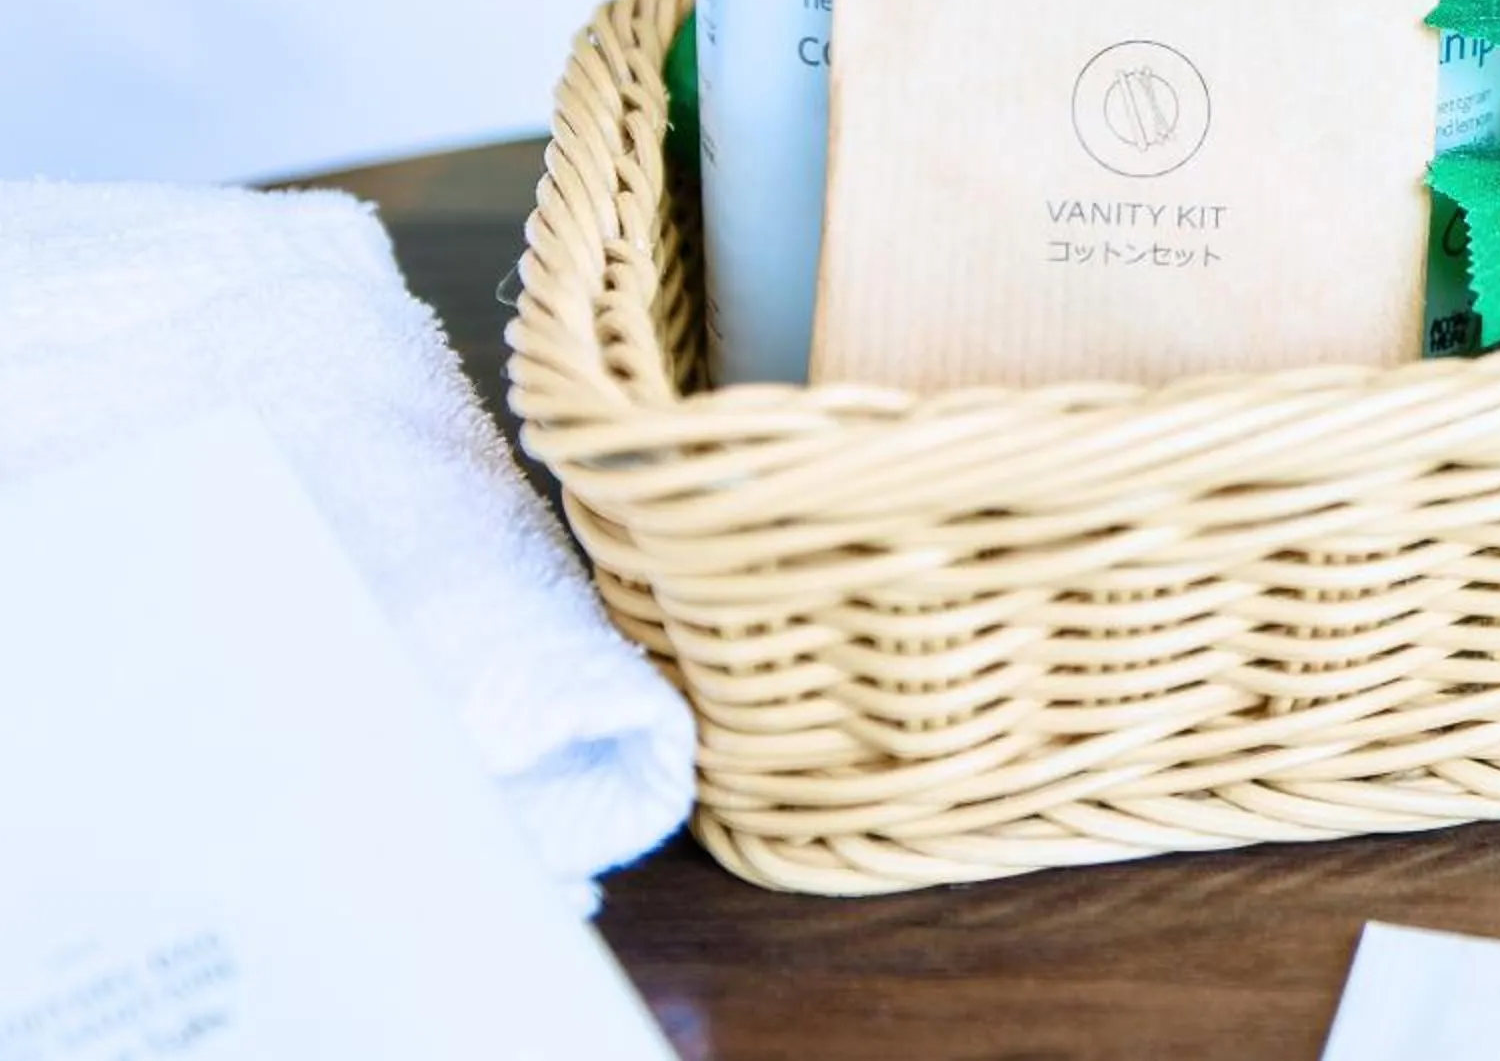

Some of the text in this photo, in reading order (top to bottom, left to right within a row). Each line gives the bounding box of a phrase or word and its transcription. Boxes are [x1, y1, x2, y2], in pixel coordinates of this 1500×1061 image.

[1047, 200, 1227, 229] VANITY KIT
[1047, 241, 1221, 267] コットンセット
